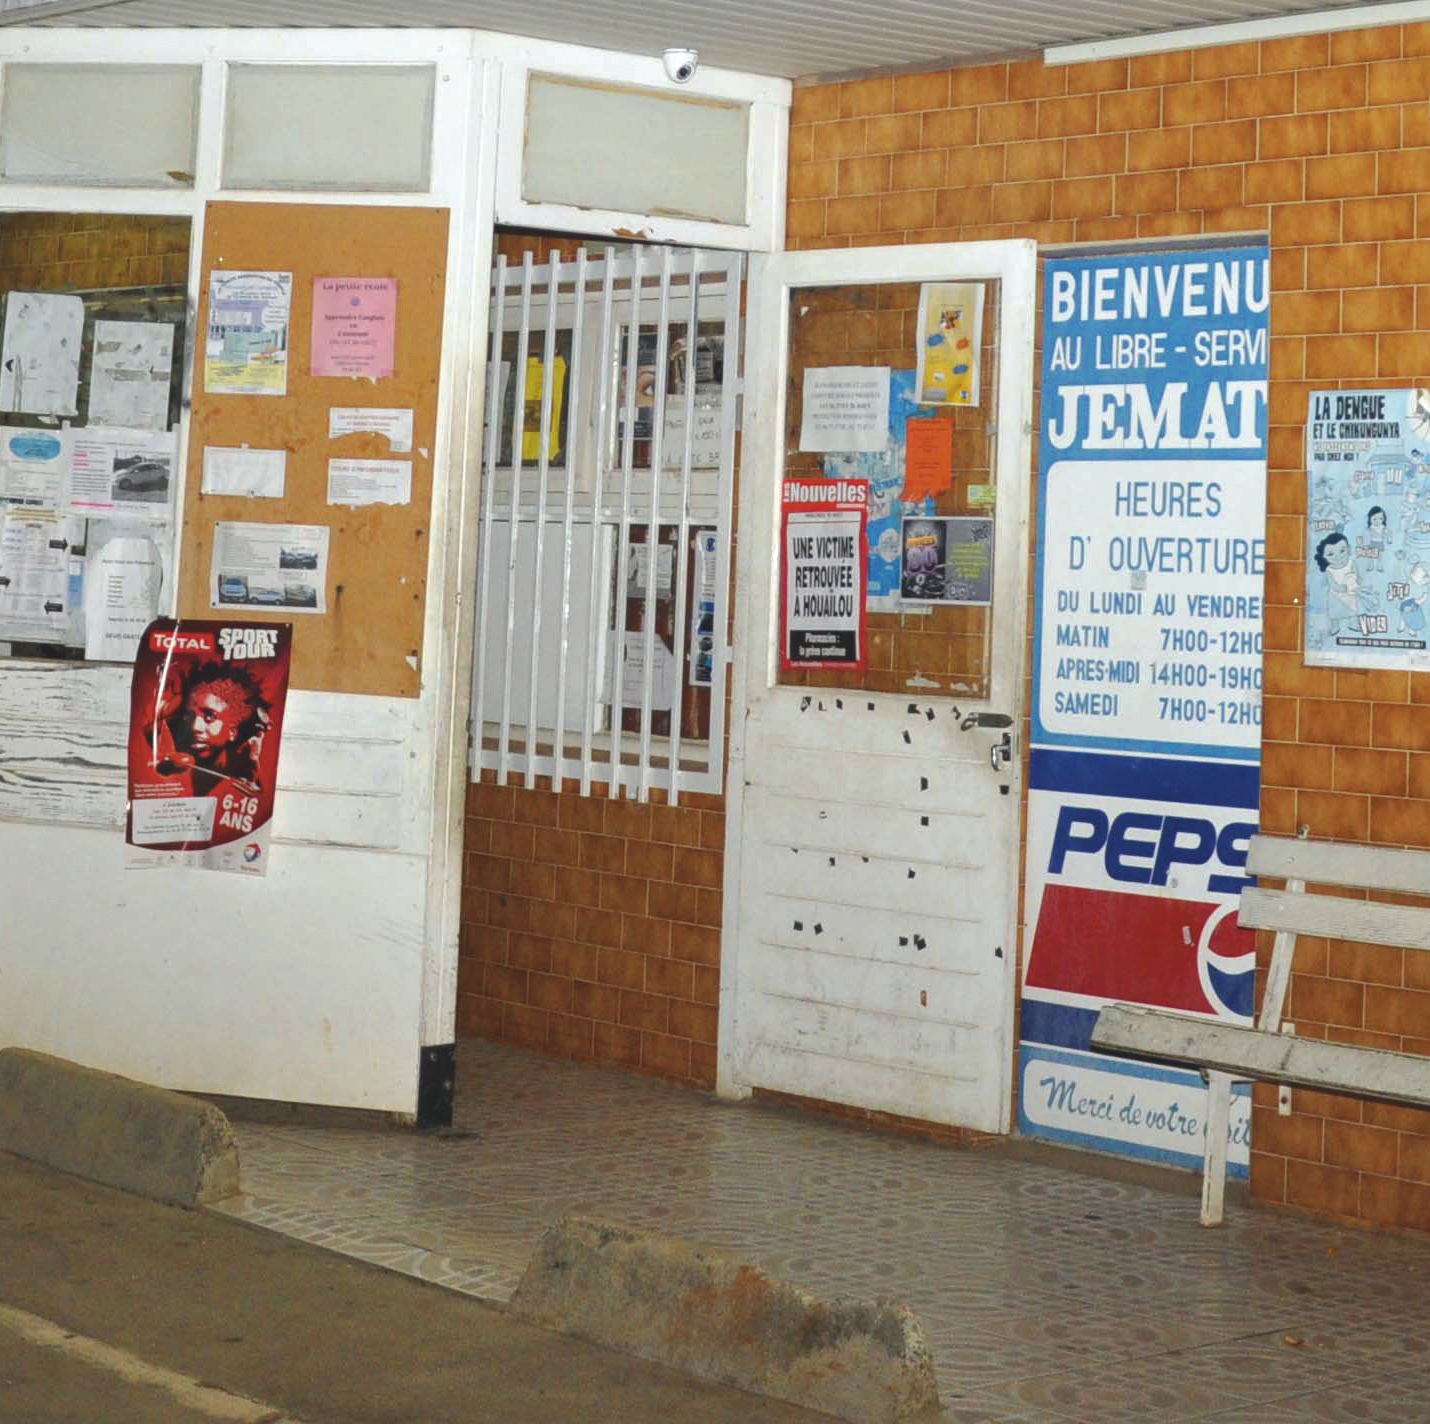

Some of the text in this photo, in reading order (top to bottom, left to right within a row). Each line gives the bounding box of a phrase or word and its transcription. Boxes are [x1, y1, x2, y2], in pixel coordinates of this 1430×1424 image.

[1052, 259, 1269, 323] BIENVENU
[1050, 336, 1082, 372] AU
[1095, 333, 1168, 370] LIBRE
[1048, 380, 1268, 450] JEMAT
[1315, 395, 1385, 421] LA DENGUE
[1313, 421, 1400, 439] ET LE CHIKUNGUNYA
[791, 480, 866, 504] Nouvelles
[1114, 481, 1222, 517] HEURES
[792, 535, 855, 560] UNE VICTIME
[1069, 535, 1267, 575] D' OUVERTURE
[795, 559, 854, 588] RETROUVÉE
[1057, 590, 1265, 620] DU LUNDI AU VENDRE
[154, 633, 211, 650] TOTAL
[218, 628, 278, 645] SPORT
[1056, 623, 1110, 649] MATIN
[223, 642, 276, 660] TOUR
[1054, 690, 1119, 717] SAMEDI
[222, 793, 259, 816] 6-16
[219, 811, 253, 833] ANS
[1047, 805, 1259, 895] PEPS
[1040, 1076, 1114, 1122] Merci
[1119, 1094, 1142, 1126] de
[1145, 1102, 1198, 1137] votre
